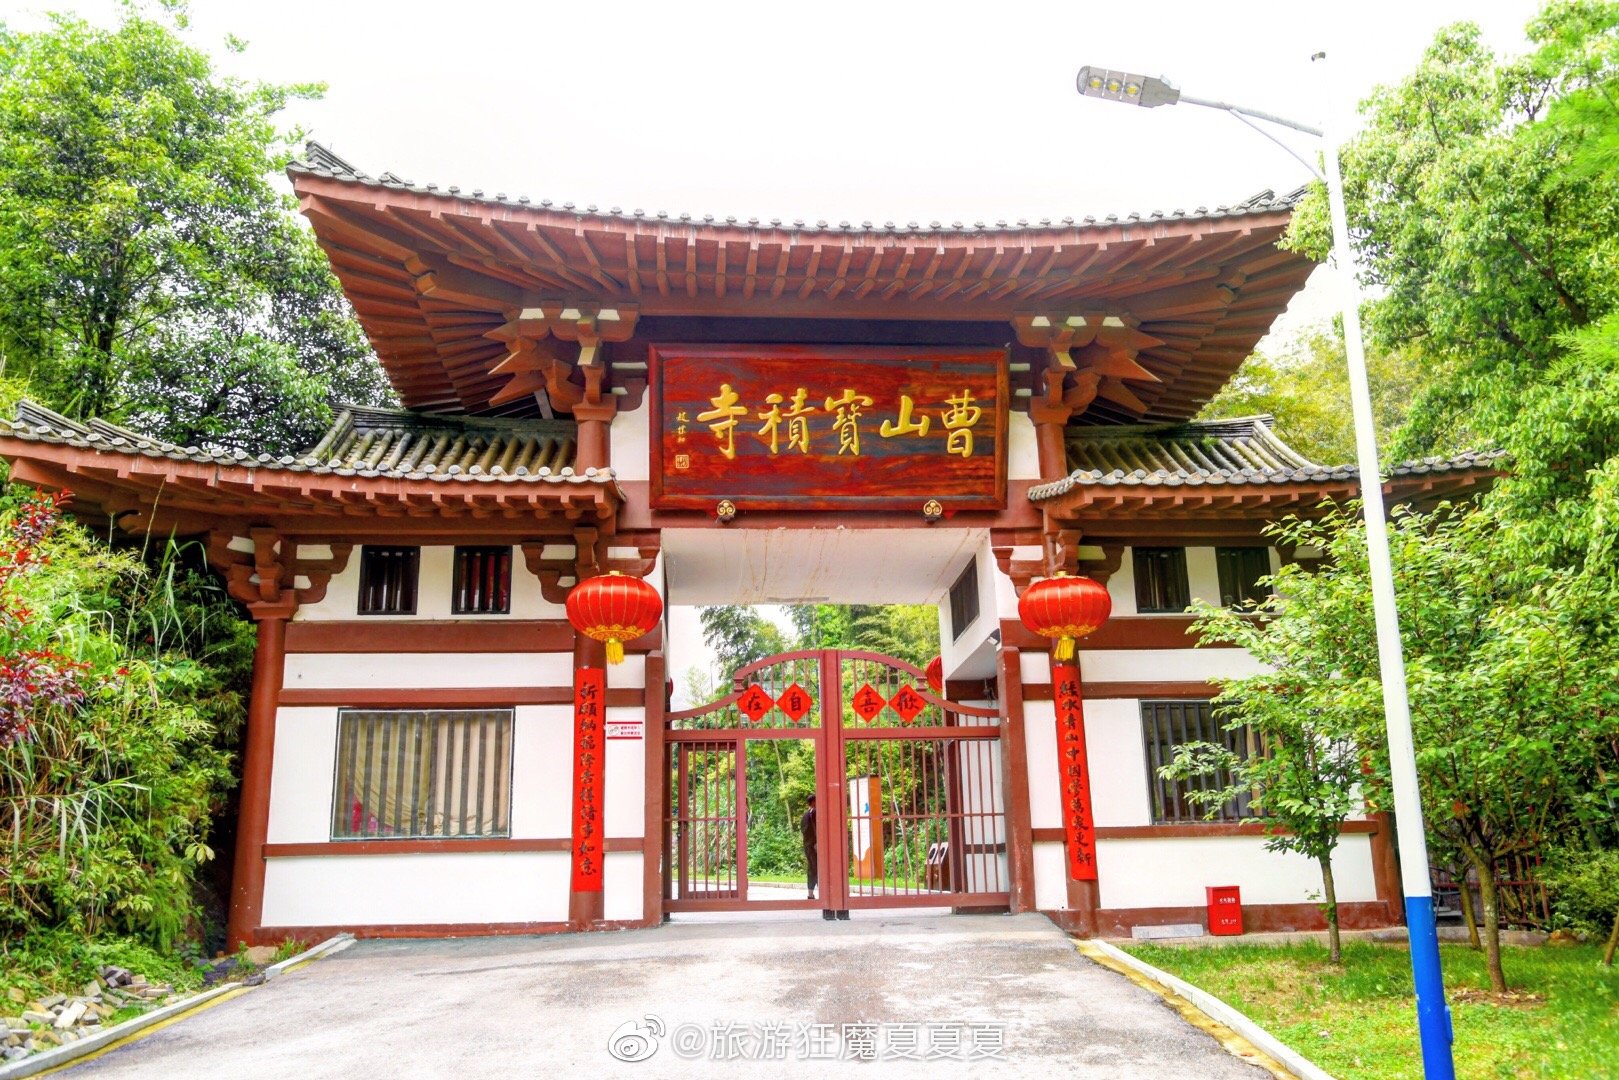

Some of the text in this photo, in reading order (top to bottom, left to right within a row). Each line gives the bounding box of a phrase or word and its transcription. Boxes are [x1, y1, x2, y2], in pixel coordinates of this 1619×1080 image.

[697, 384, 982, 459] 曹山寶積寺
[790, 691, 802, 711] 自
[859, 689, 878, 712] 喜
